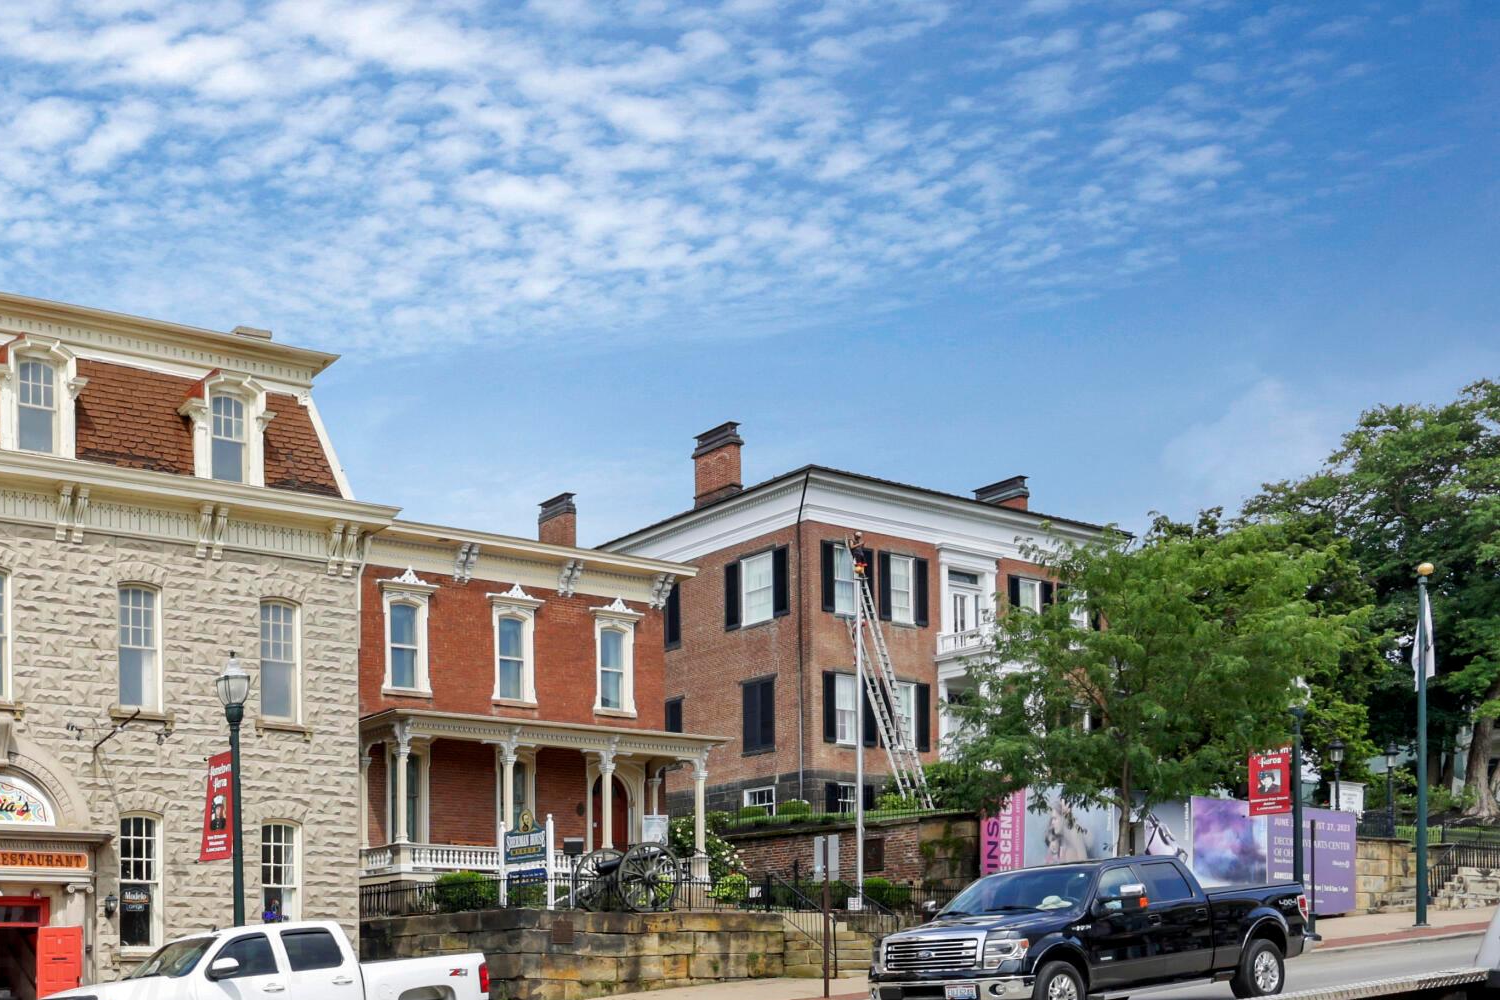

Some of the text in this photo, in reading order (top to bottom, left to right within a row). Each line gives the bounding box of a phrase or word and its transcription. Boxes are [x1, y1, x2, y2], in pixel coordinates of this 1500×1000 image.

[1275, 818, 1290, 827] JUNE
[1302, 820, 1325, 831] AUUST
[506, 831, 545, 852] SHERMAN HOUSE
[1275, 837, 1350, 851] DECOIVE ARTS CENTER
[1275, 848, 1282, 856] OF
